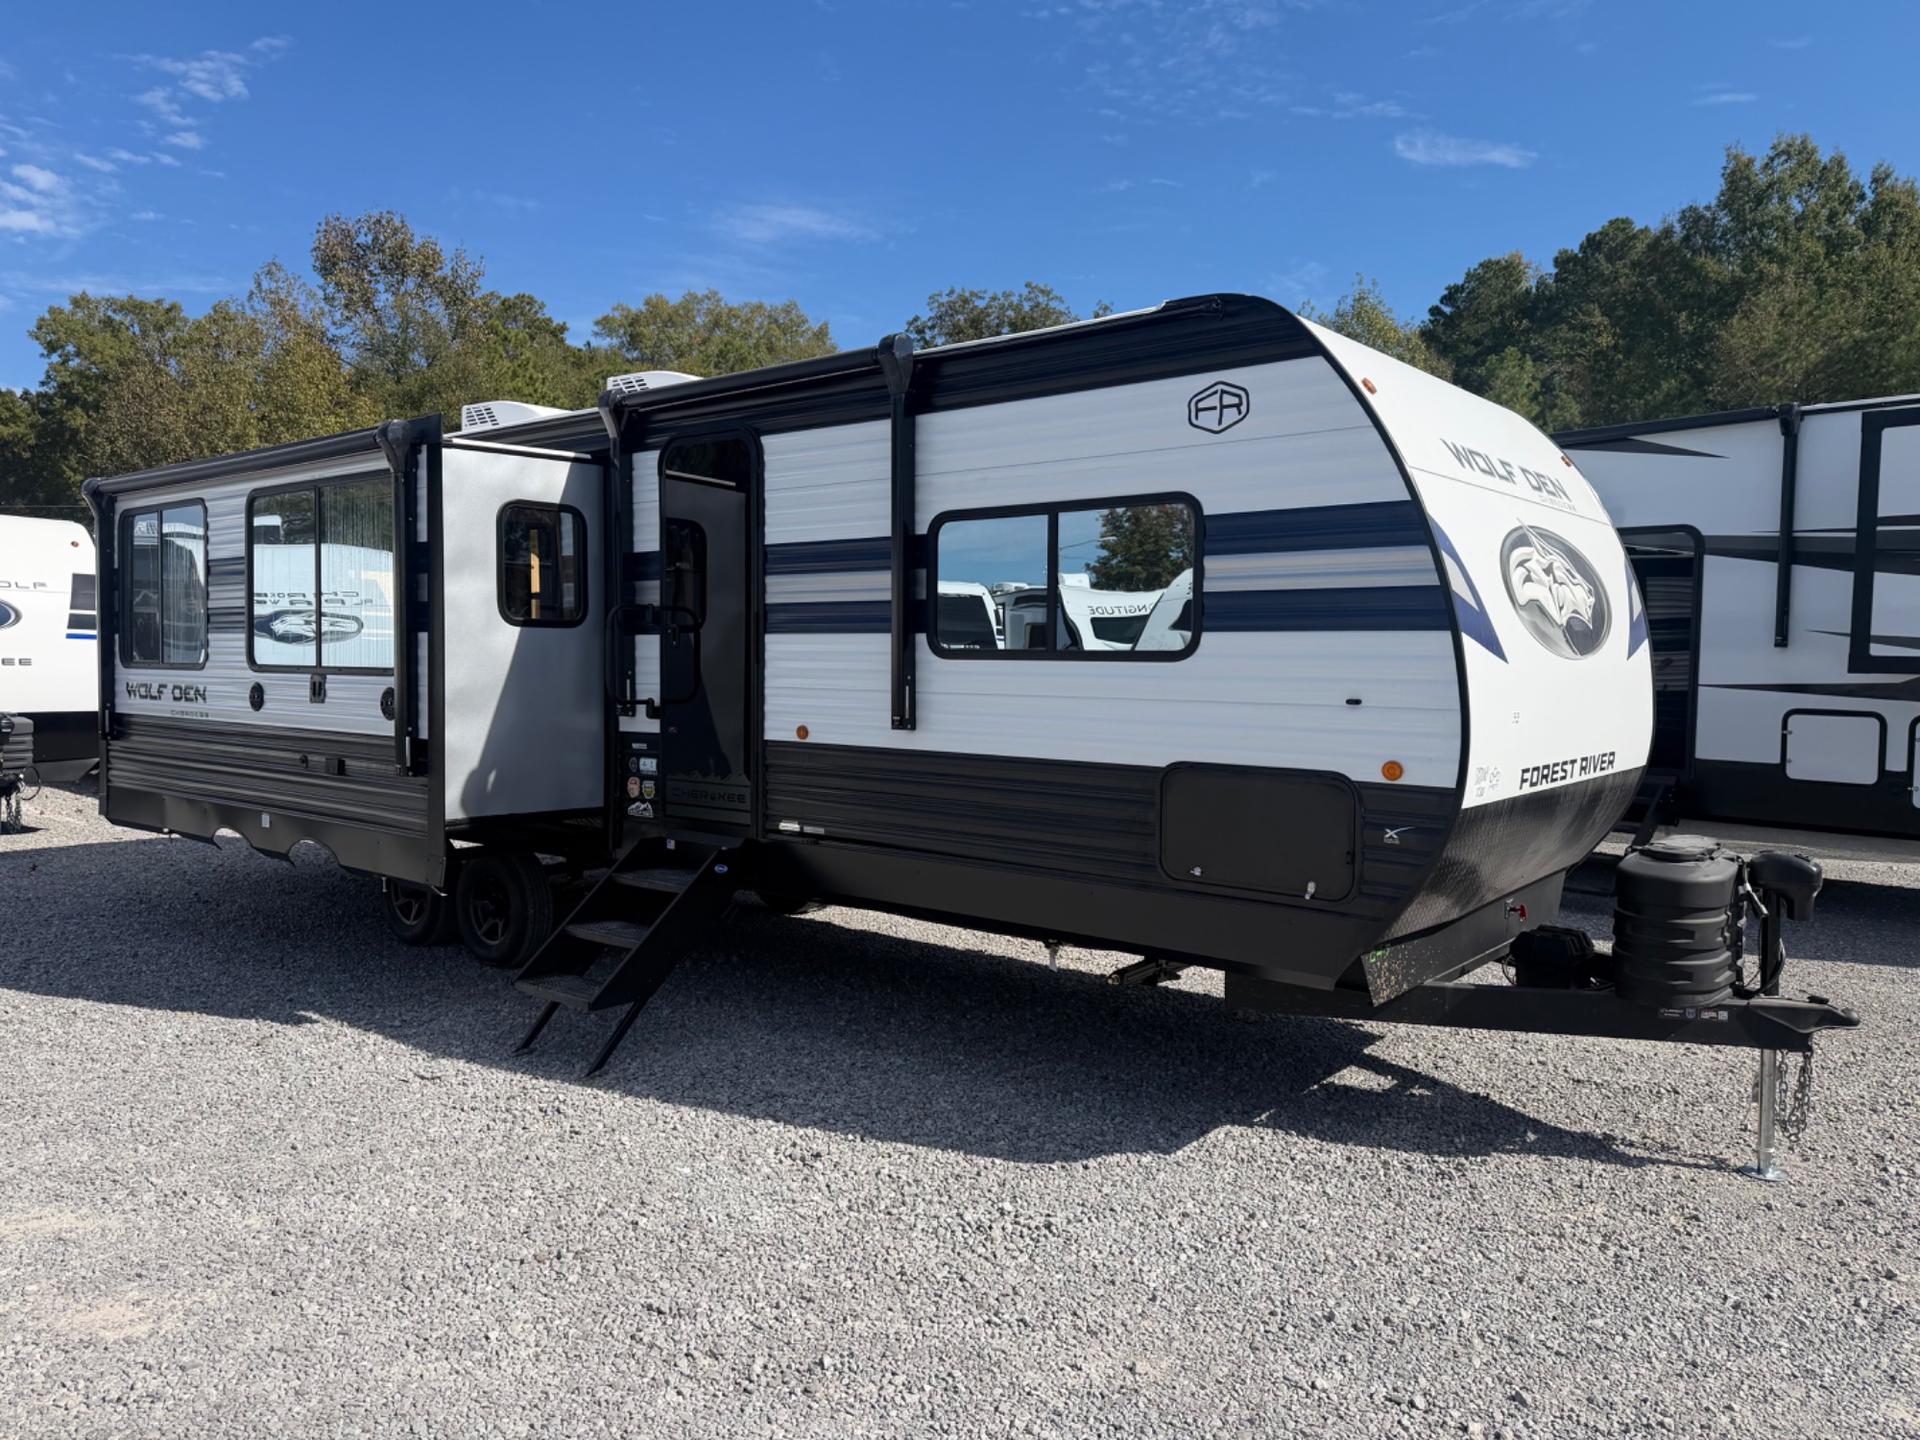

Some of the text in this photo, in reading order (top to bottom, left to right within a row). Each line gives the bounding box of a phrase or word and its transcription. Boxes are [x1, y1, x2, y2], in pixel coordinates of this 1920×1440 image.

[1439, 437, 1517, 485] WOLF
[1518, 465, 1572, 502] DEN
[126, 681, 207, 703] WOLF DEN
[1519, 758, 1578, 790] FOREST
[1579, 751, 1616, 777] RIVER
